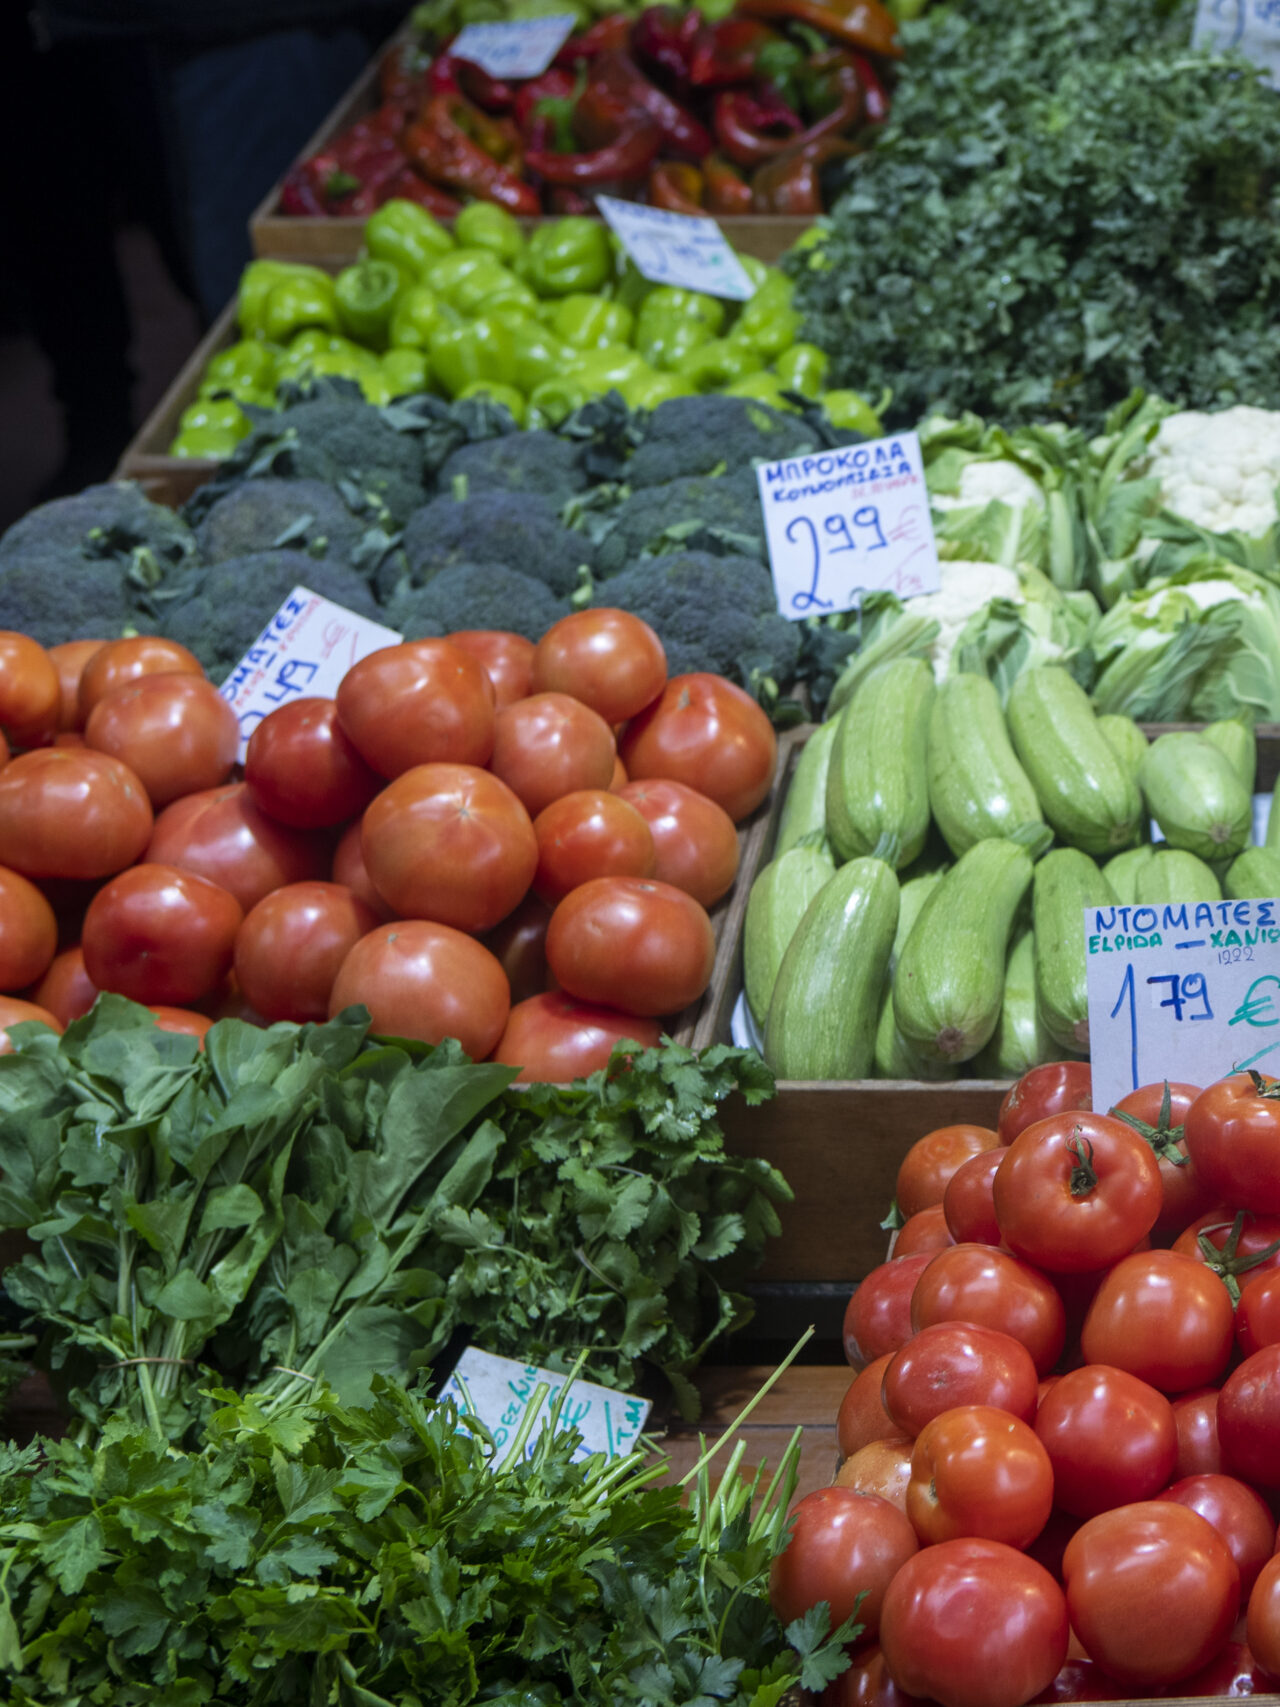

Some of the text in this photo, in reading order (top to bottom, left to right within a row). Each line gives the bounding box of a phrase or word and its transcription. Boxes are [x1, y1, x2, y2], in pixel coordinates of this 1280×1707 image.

[766, 440, 905, 484] ΜΠΡΟΚΟΛΑ
[220, 597, 307, 702] ΟΜΑΤΕΣ
[1096, 901, 1277, 934] ΝΤΟΜΑΤΕΣ
[1089, 932, 1163, 955] ELPIDA
[1218, 946, 1255, 966] 1222
